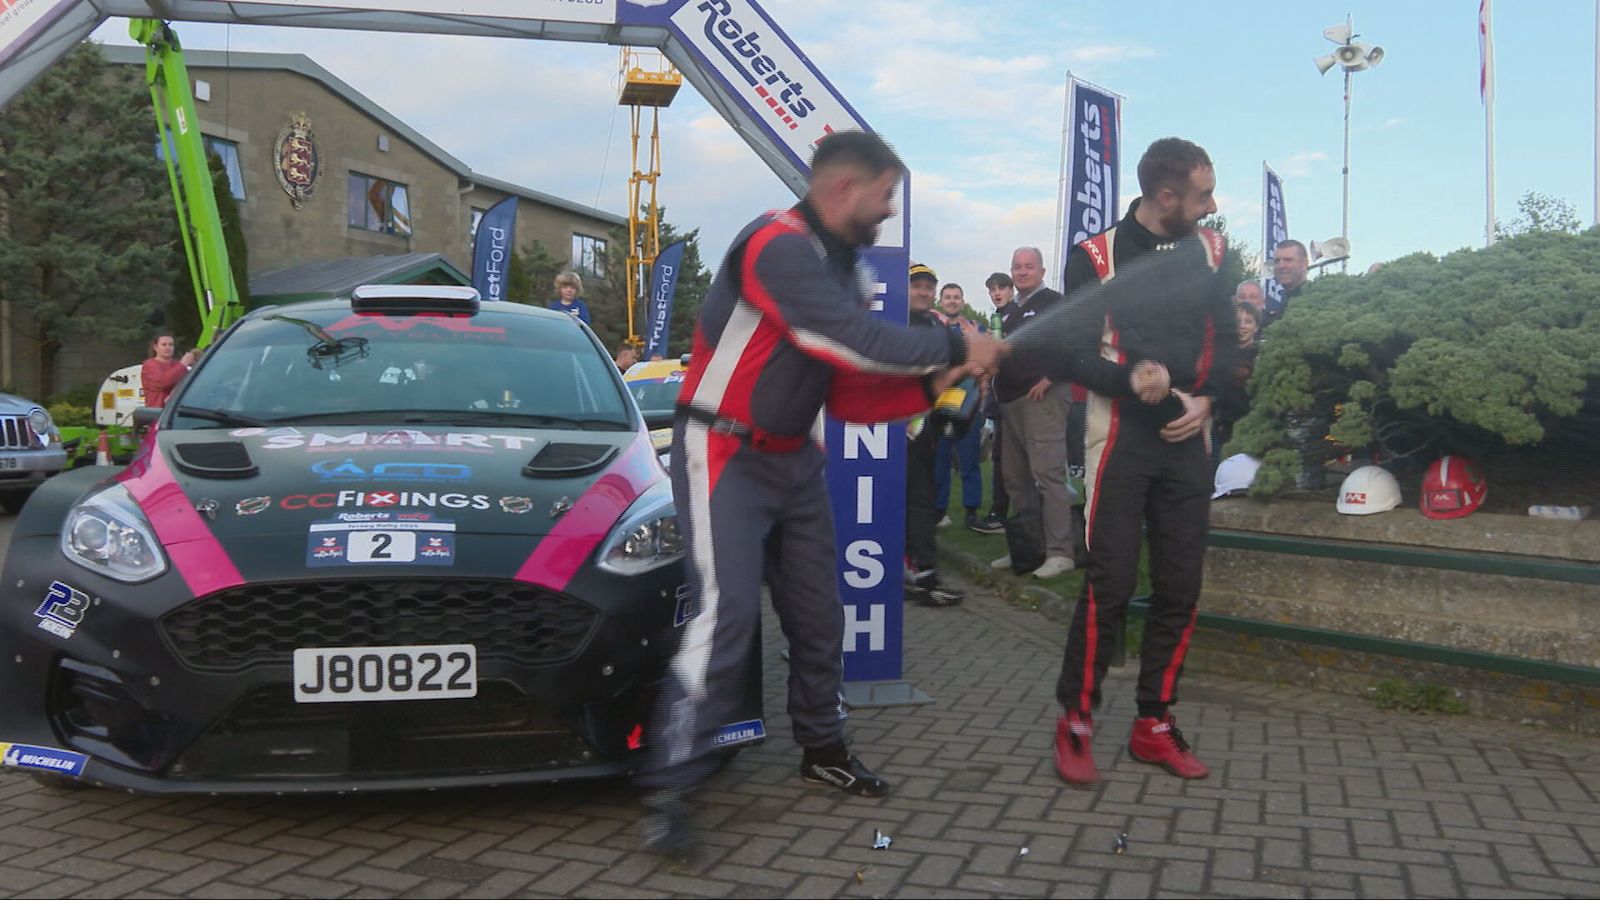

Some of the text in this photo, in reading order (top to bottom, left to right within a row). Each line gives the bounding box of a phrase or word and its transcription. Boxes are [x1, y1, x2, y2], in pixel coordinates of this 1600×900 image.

[697, 0, 816, 119] Roberts
[1073, 100, 1103, 244] oberts
[487, 227, 505, 300] stFord
[1268, 183, 1287, 302] Rerts
[649, 264, 674, 350] TrustFord
[260, 429, 536, 450] SMART
[842, 282, 889, 652] NISH
[338, 512, 392, 521] Roberts
[370, 533, 393, 559] 2
[300, 652, 472, 694] J80822
[20, 753, 76, 771] MICHELIN
[713, 727, 756, 745] ICHELIN
